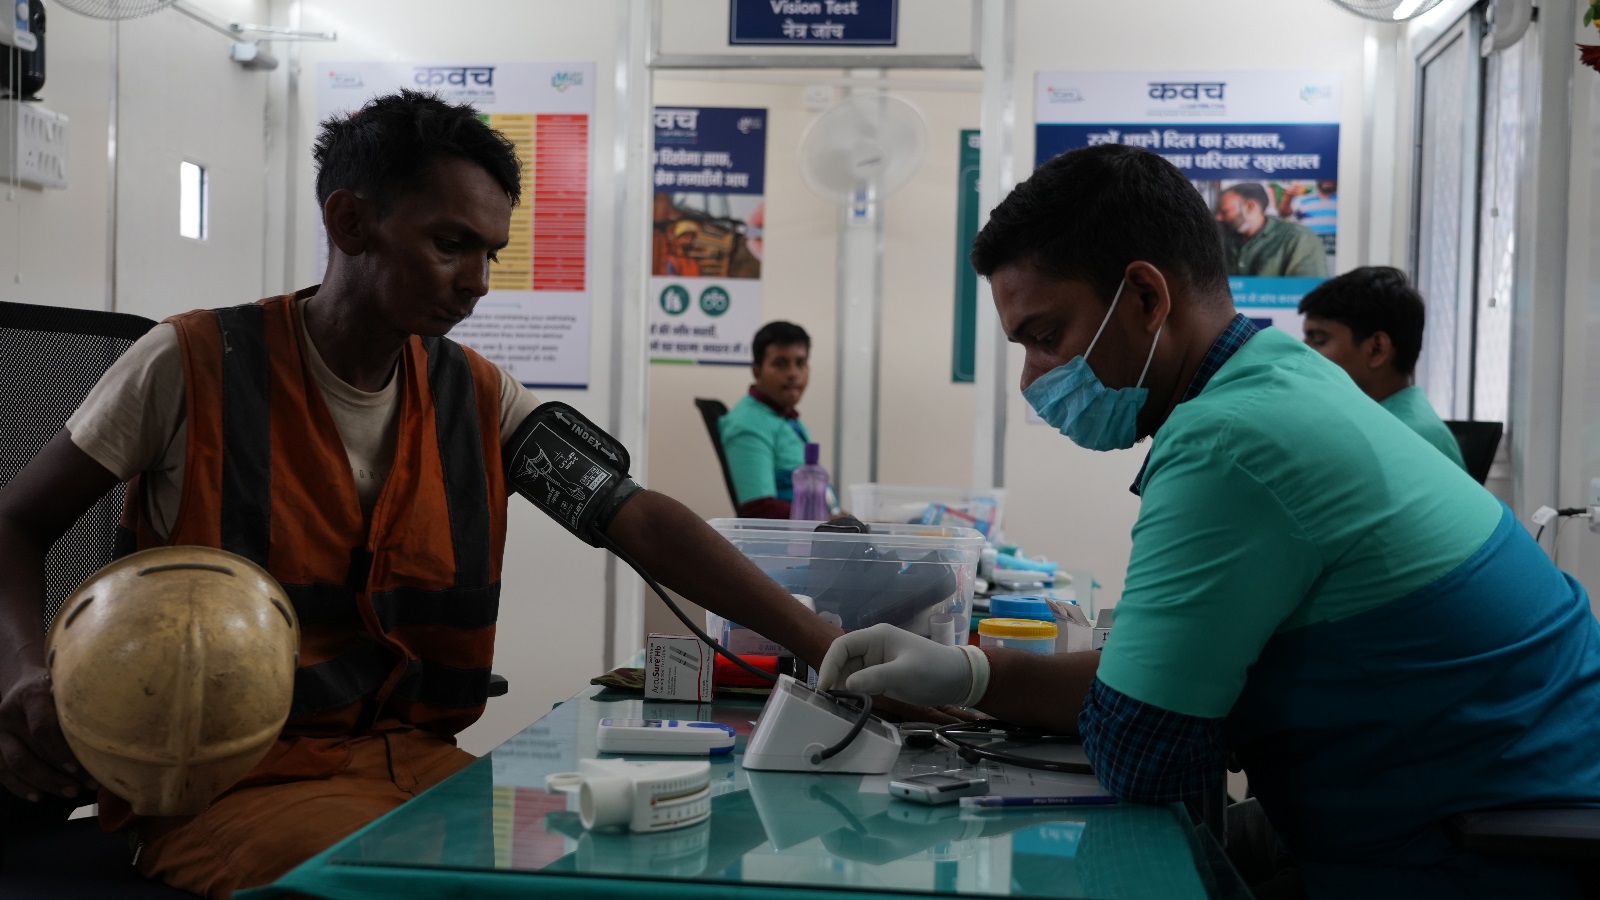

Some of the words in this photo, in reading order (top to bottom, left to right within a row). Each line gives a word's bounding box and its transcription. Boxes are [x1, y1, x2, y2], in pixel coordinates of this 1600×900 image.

[770, 0, 821, 15] Vision
[826, 1, 859, 15] Test
[781, 18, 808, 38] नेत्र
[413, 66, 496, 88] कवच
[1147, 82, 1226, 102] कवच
[654, 109, 699, 130] वच
[1163, 129, 1196, 149] दिल
[1198, 133, 1222, 149] का
[1194, 150, 1251, 169] परिवार
[1252, 153, 1321, 173] खुशहाल
[571, 423, 602, 451] INDEX
